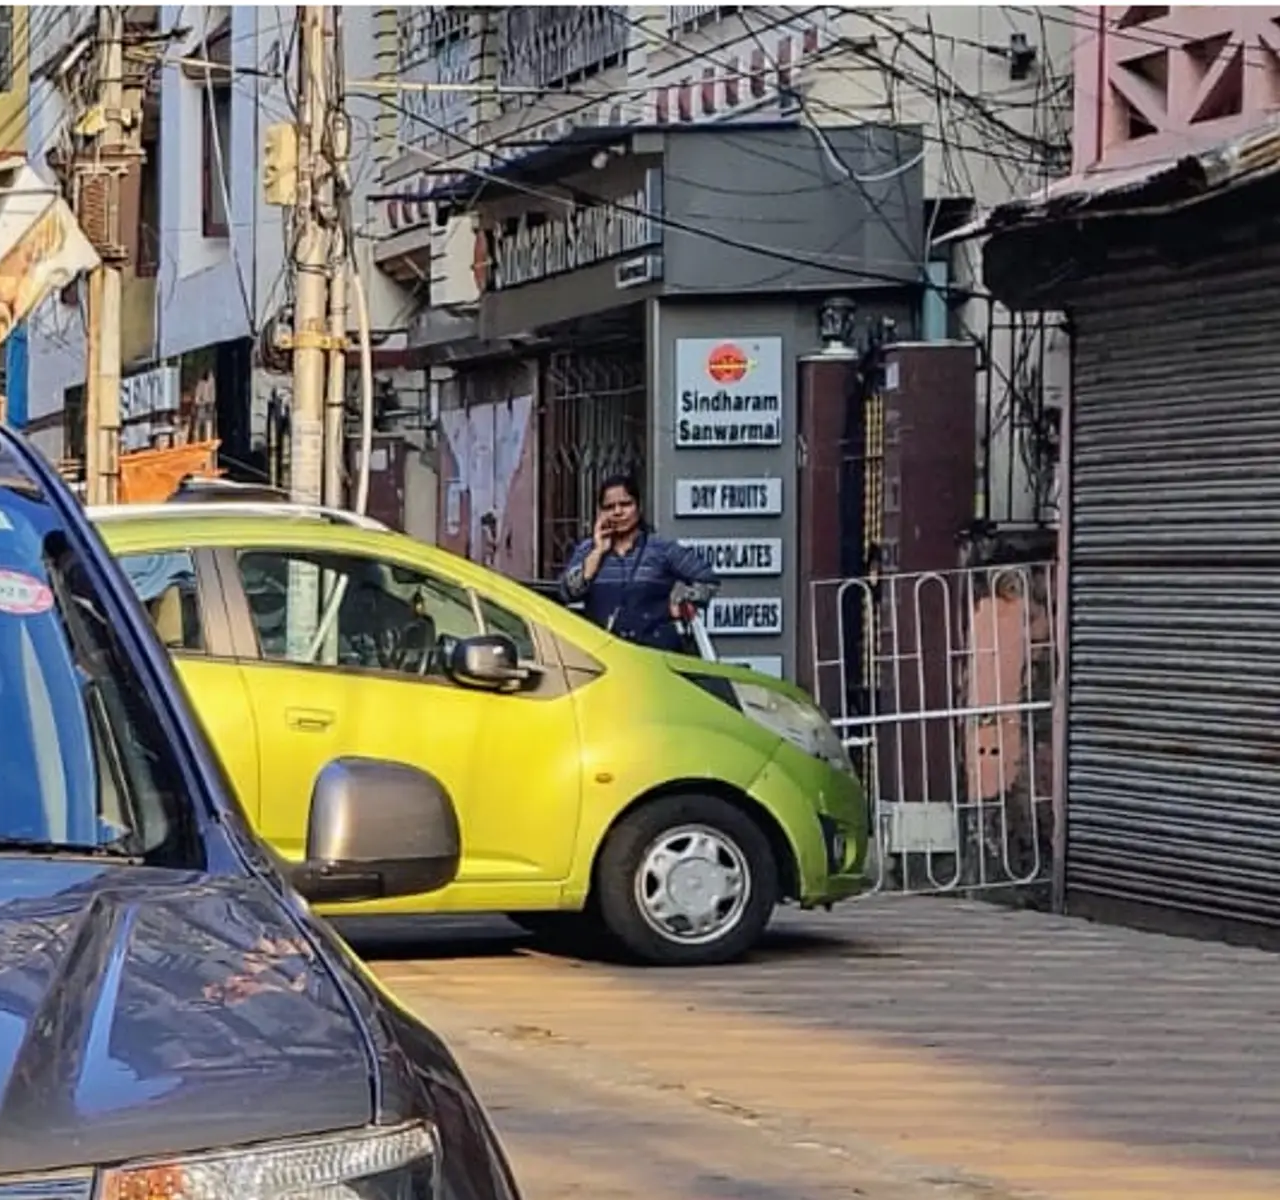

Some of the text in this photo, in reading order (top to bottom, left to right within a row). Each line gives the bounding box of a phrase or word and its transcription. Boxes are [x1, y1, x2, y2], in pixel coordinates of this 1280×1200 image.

[682, 389, 778, 412] Sindharam
[680, 418, 780, 441] Sanwarmal
[691, 485, 768, 509] DRY FRUITS
[713, 604, 778, 627] HAMPERS
